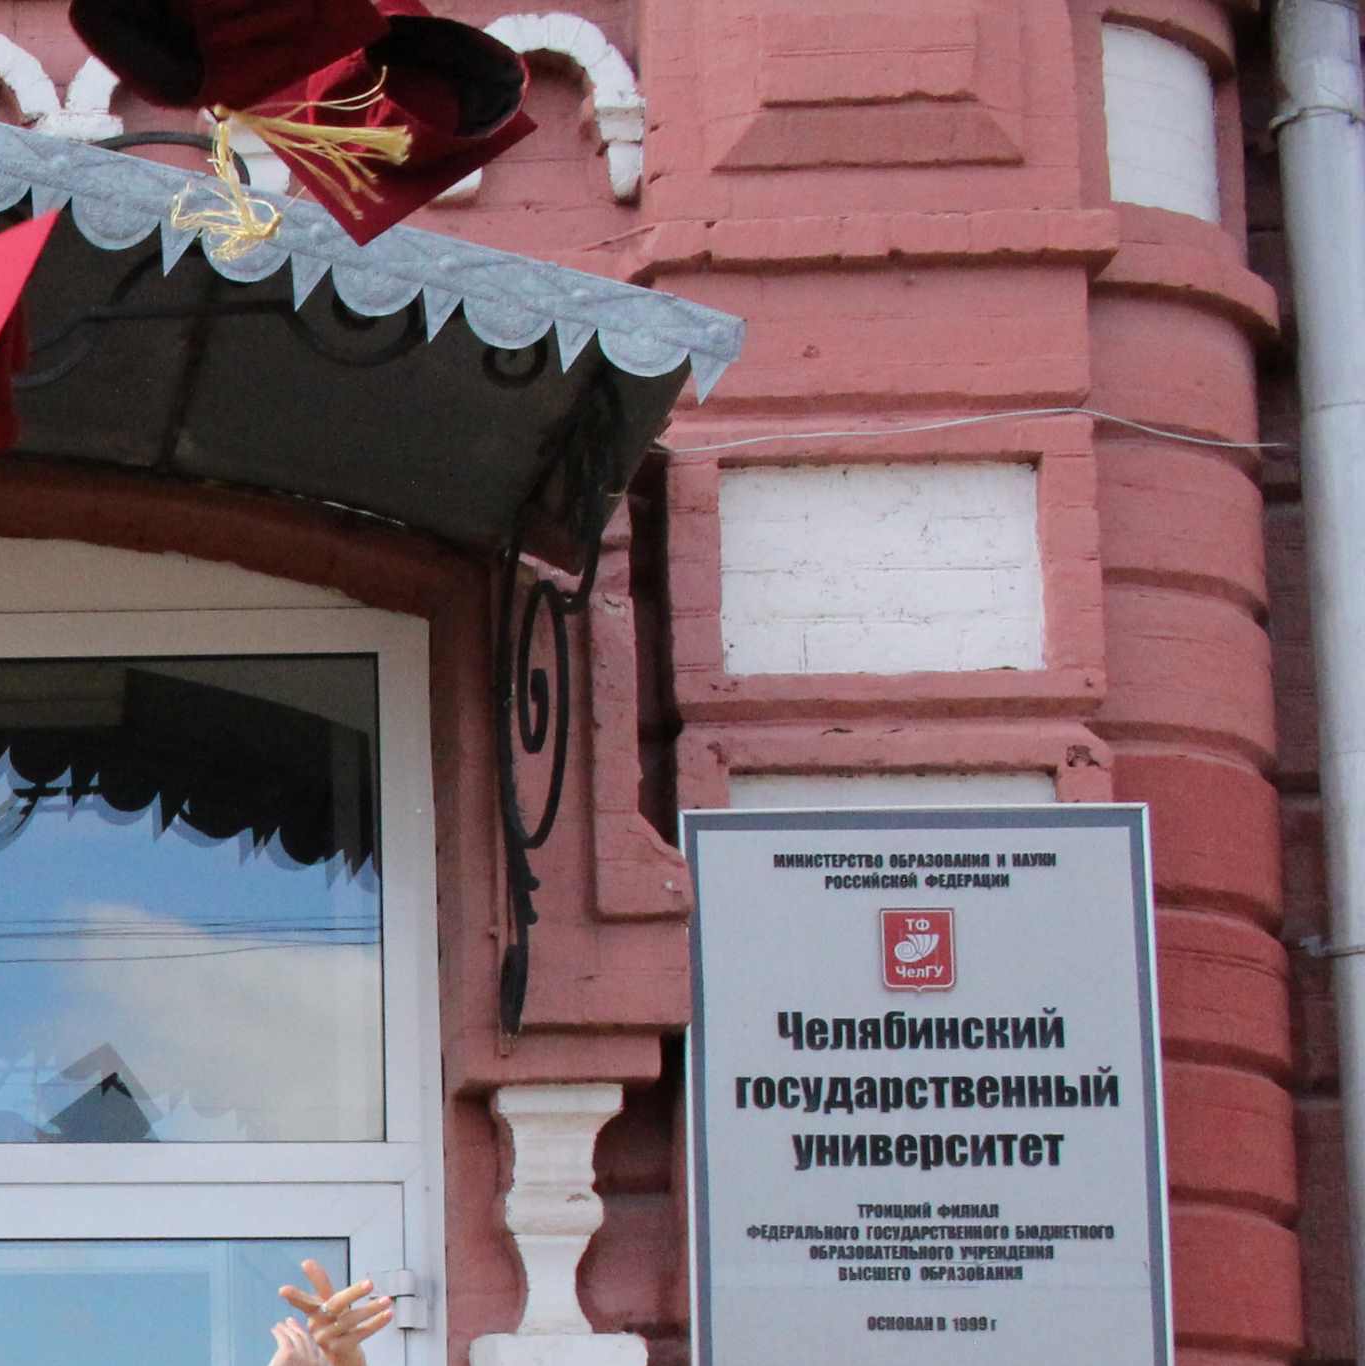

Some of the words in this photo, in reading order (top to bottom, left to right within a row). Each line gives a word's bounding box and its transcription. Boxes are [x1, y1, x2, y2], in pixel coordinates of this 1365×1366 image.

[773, 853, 884, 868] МИНИСТЕРСТВО
[890, 853, 990, 868] ОБРАЗОВАНИЯ
[997, 853, 1006, 867] И
[1012, 853, 1057, 867] НАУКИ
[825, 872, 918, 889] РОССИЙСКОЙ
[924, 873, 1010, 889] ФЕДЕРАЦИИ
[904, 918, 931, 931] ТФ
[895, 965, 944, 979] ЧелГУ
[777, 1008, 1065, 1051] Челябинский
[735, 1066, 1119, 1114] государственный
[793, 1132, 1065, 1171] университет
[858, 1202, 932, 1220] ТРОИЦКИЙ
[937, 1203, 999, 1219] ФИЛИАЛ
[746, 1224, 859, 1242] ФЕДЕРАЛЬНОГО
[866, 1225, 1010, 1242] ГОСУДАРСТВЕННОГО
[1015, 1224, 1115, 1241] БЮДЖЕТНОГО
[809, 1245, 954, 1260] ОБРАЗОВАТЕЛЬНОГО
[960, 1245, 1054, 1261] УЧРЕЖДЕНИЯ
[838, 1266, 911, 1281] ВЫСШЕГО
[920, 1266, 1023, 1281] ОБРАЗОВАНИЯ
[867, 1316, 933, 1331] ОСНОВАН
[936, 1317, 946, 1331] В
[952, 1316, 988, 1332] 1999
